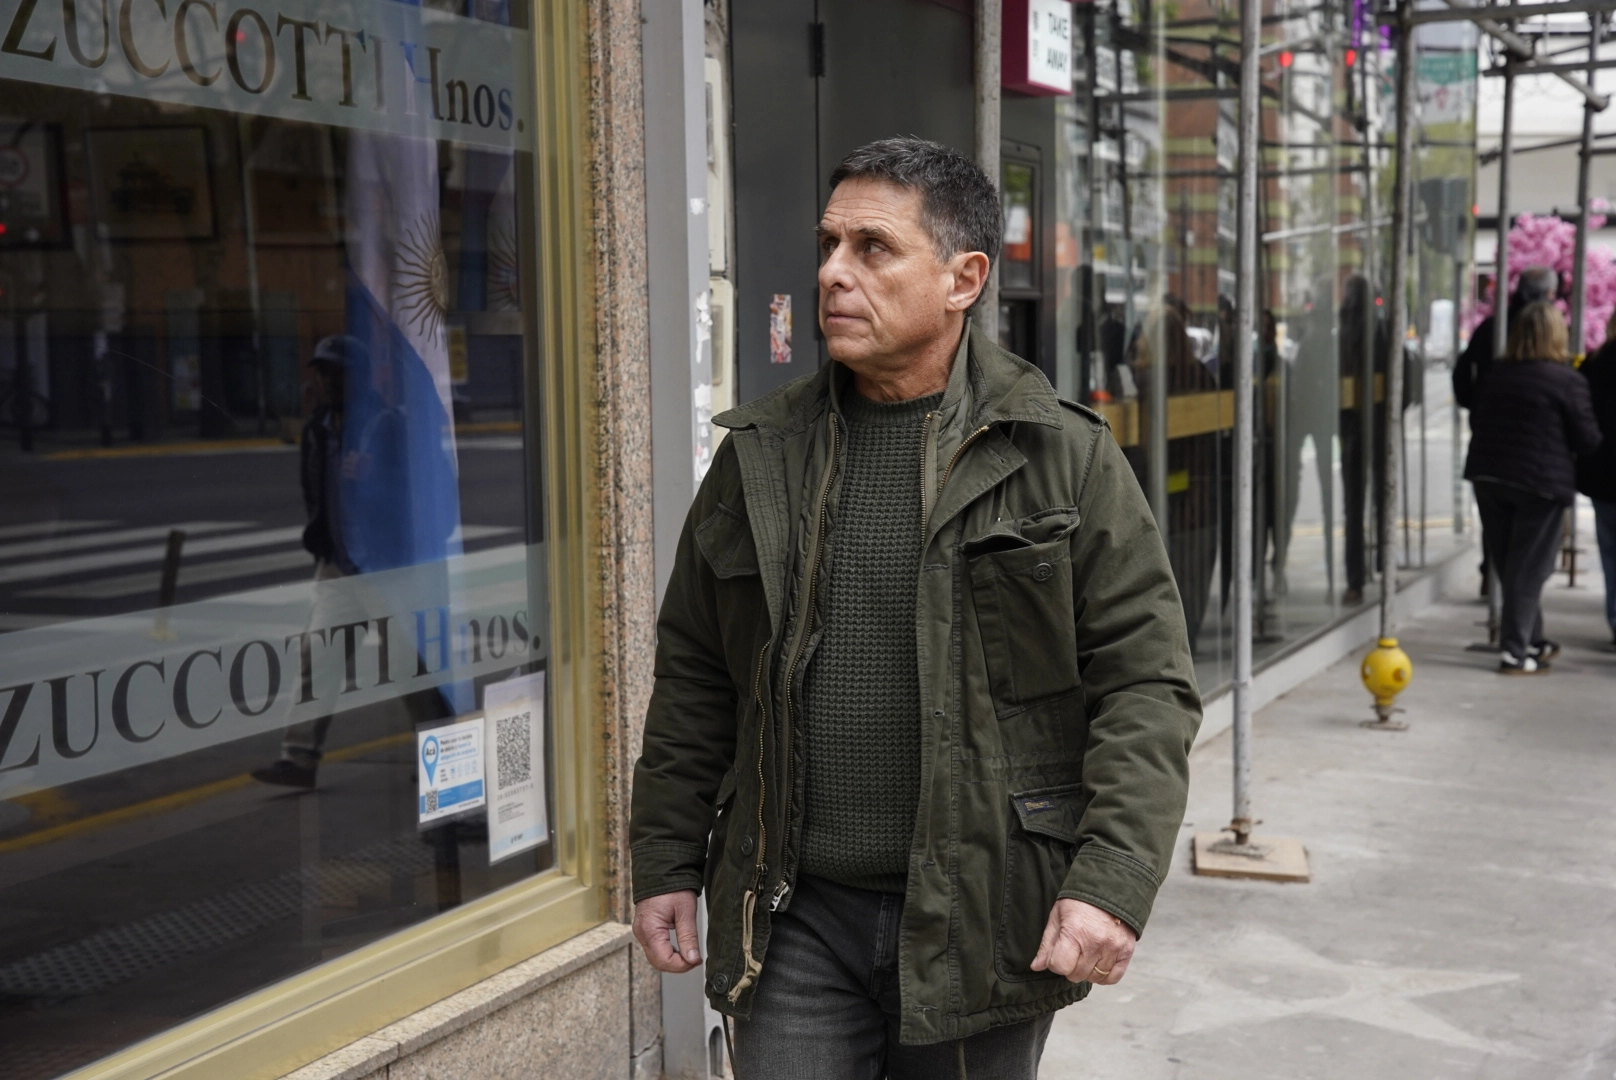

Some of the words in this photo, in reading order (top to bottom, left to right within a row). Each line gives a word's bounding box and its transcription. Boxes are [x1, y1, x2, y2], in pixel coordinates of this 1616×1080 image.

[1047, 11, 1068, 40] TAKE
[401, 41, 525, 133] Hnos.
[1047, 47, 1068, 73] AWAY
[0, 616, 395, 773] ZUCCOTTI
[411, 606, 541, 678] Hnos.
